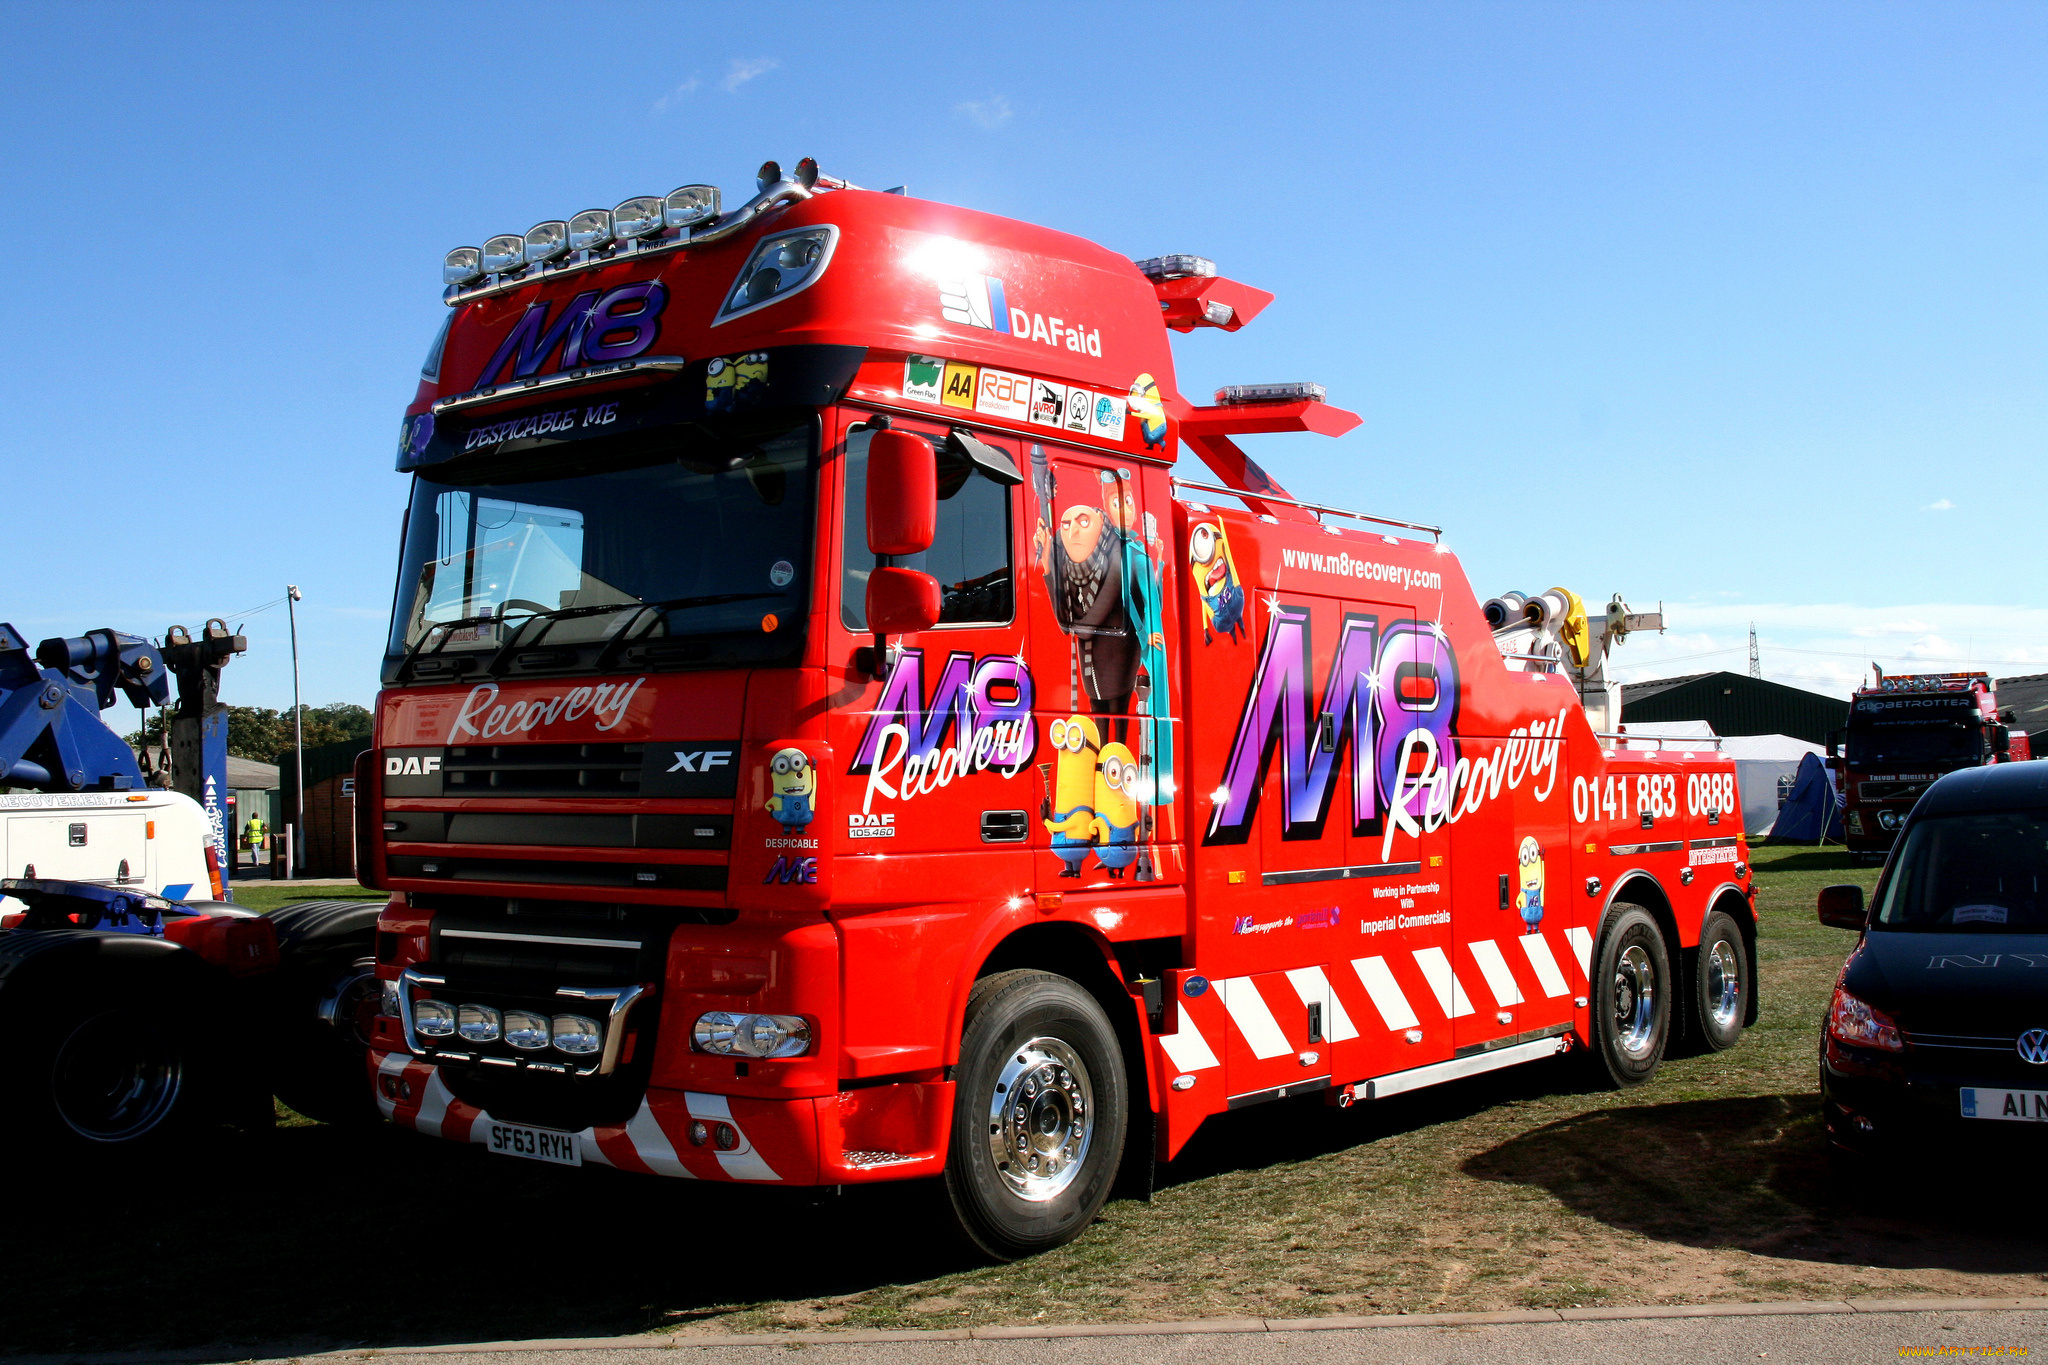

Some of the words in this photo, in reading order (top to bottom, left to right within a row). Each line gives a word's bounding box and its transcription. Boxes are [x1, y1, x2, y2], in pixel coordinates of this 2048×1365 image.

[474, 282, 670, 390] M8
[1010, 307, 1102, 358] DAFaid
[906, 387, 924, 398] Green
[925, 390, 937, 400] Flag
[947, 373, 971, 398] AA
[979, 399, 1010, 411] breakdown
[1033, 402, 1056, 414] AVRO
[465, 410, 576, 450] DESPICABLE
[582, 402, 620, 428] ME
[1102, 413, 1122, 426] IFRS
[1282, 548, 1442, 590] www.m8recovery.com
[446, 677, 646, 746] Recovery
[846, 646, 1036, 775] M8
[1857, 699, 1970, 711] GLOBETROTTER
[1201, 605, 1460, 847] M8
[385, 756, 443, 776] DAF
[665, 751, 733, 772] XF
[863, 712, 1030, 816] Recovery
[1382, 708, 1567, 863] Recovery
[1572, 775, 1628, 823] 0141
[1636, 774, 1677, 819] 883
[1687, 773, 1735, 816] 0888
[848, 814, 895, 826] DAF
[765, 838, 819, 849] DESPICABLE
[848, 827, 895, 838] 105.460
[1689, 846, 1738, 866] INTERSTATER
[1372, 886, 1399, 898] Working
[1399, 885, 1405, 895] in
[1406, 882, 1440, 895] Partnership
[1400, 898, 1415, 909] With
[1360, 917, 1397, 937] Imperial
[1397, 910, 1451, 930] Commercials
[491, 1124, 536, 1156] SF63
[539, 1131, 573, 1161] RYH
